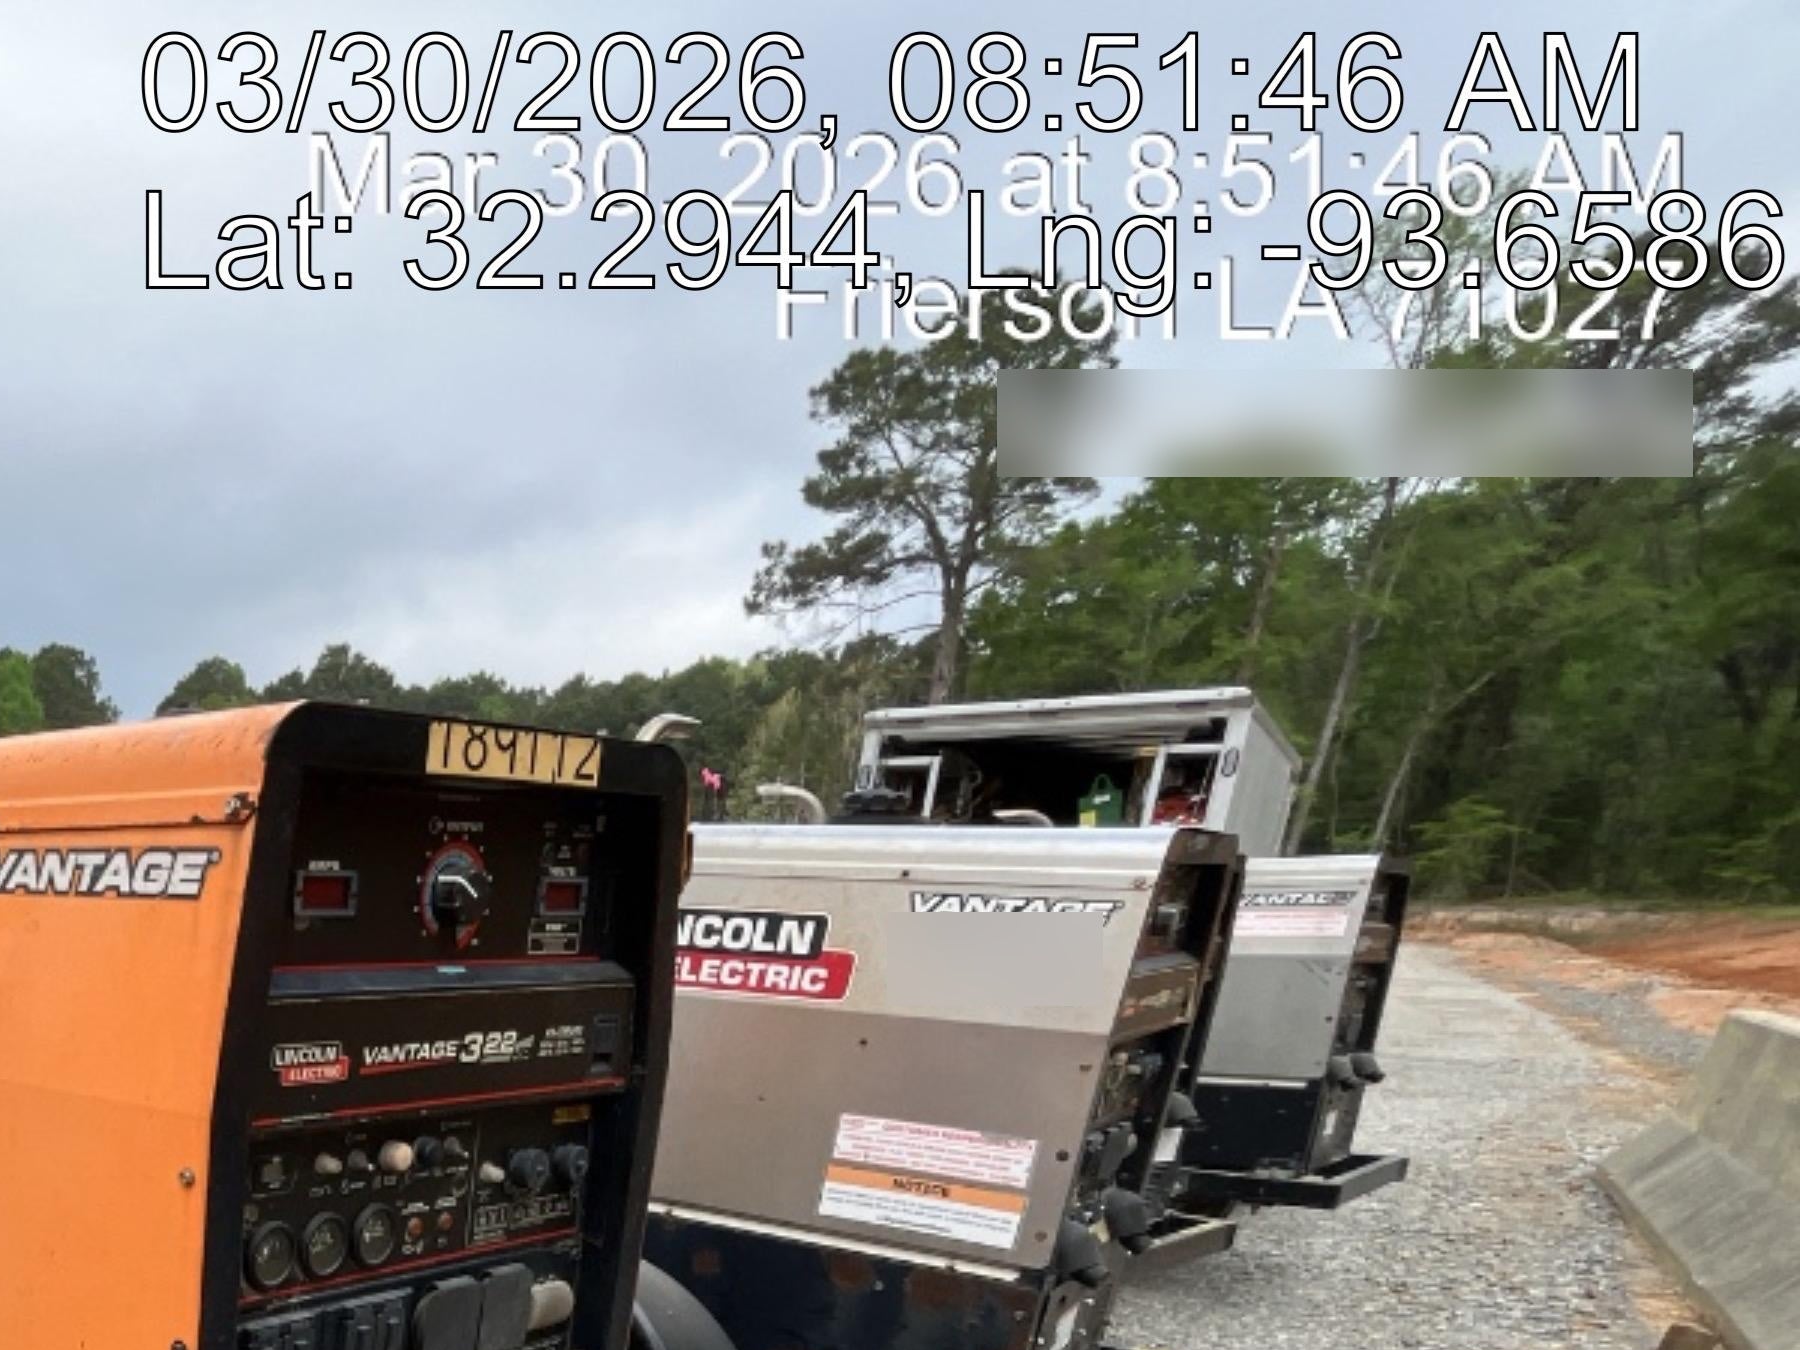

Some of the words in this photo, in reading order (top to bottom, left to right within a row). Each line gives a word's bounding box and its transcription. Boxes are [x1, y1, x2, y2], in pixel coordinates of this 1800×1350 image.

[437, 718, 598, 782] 189112
[677, 913, 818, 955] NCOLN
[274, 1044, 338, 1066] LINCOLN
[361, 1040, 460, 1065] VANTAGE
[458, 1031, 517, 1064] 322
